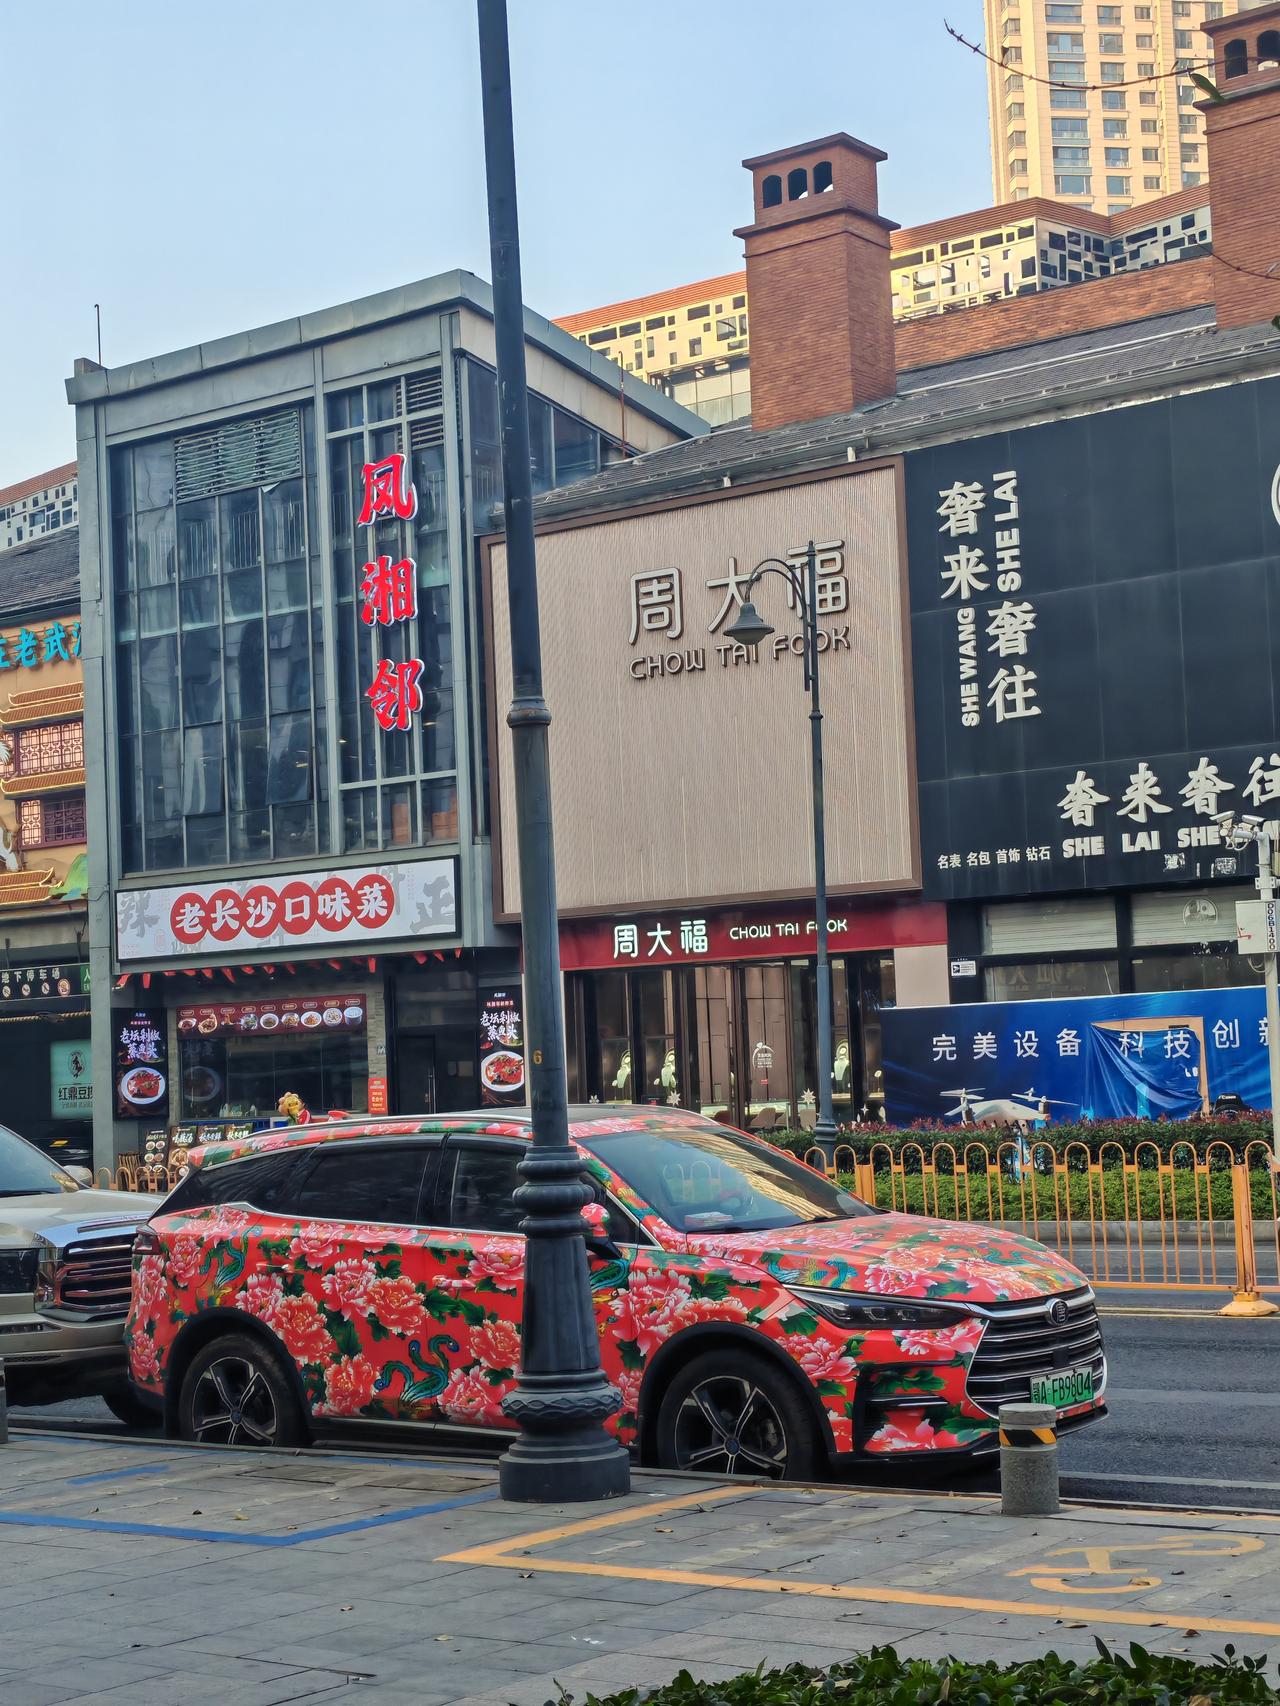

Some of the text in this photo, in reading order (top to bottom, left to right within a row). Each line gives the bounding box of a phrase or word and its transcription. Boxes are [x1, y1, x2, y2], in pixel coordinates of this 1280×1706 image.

[936, 481, 990, 600] 奢来
[993, 470, 1022, 593] SHE LAI
[357, 453, 424, 731] 凤湘邻
[628, 539, 850, 646] 周大福
[629, 626, 851, 680] CHOW TAI FOOK
[957, 607, 980, 727] SHE WANG
[985, 601, 1042, 724] 奢往
[937, 846, 1051, 870] 名表 名包 首饰 钻石
[1062, 835, 1105, 859] SHE
[1122, 831, 1161, 853] LAI
[1177, 825, 1221, 849] SHE
[175, 881, 388, 934] 老长沙口味菜
[729, 919, 848, 940] CHOW TAI FOK
[613, 919, 708, 960] 周大福
[533, 1050, 543, 1065] 6
[932, 1027, 1082, 1062] 完美设备
